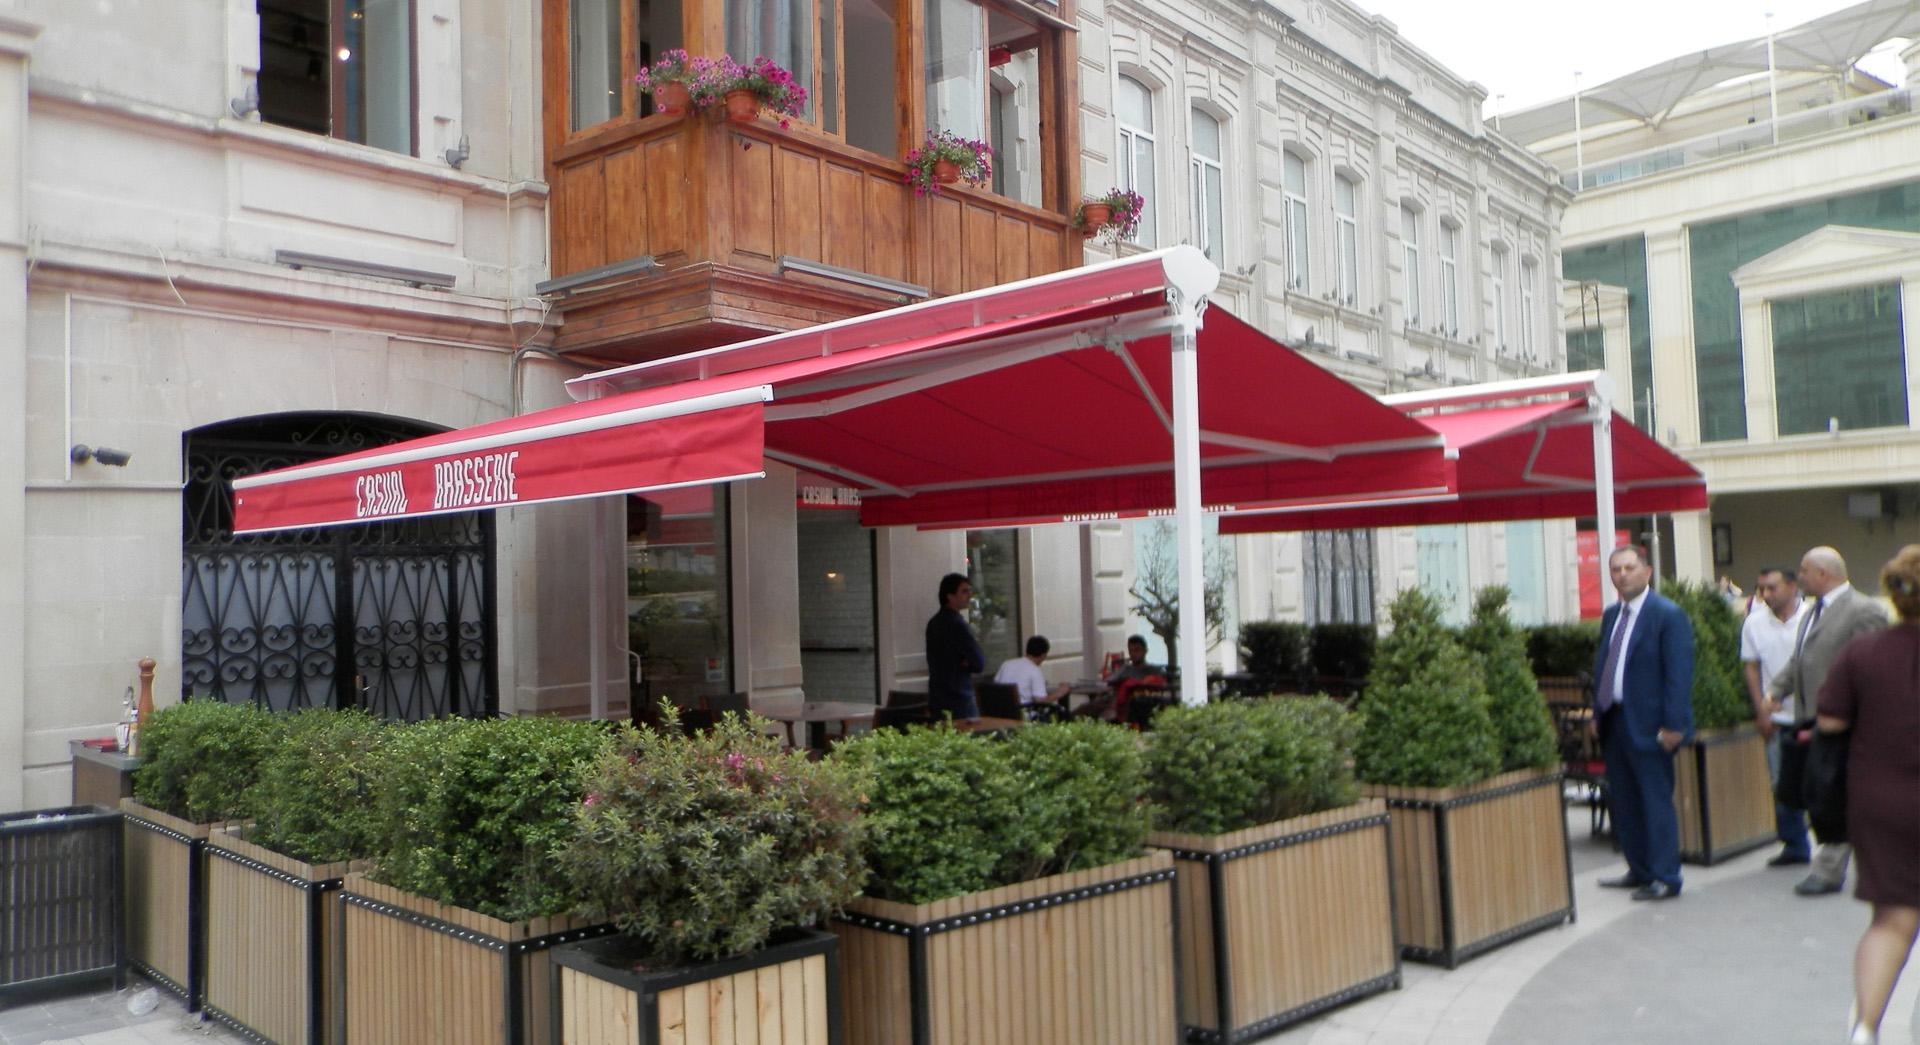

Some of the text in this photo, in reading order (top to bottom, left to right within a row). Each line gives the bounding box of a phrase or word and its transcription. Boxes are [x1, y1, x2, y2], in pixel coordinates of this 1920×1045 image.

[356, 451, 519, 517] CASUAL BRASSERIE
[803, 486, 836, 505] CASUAL
